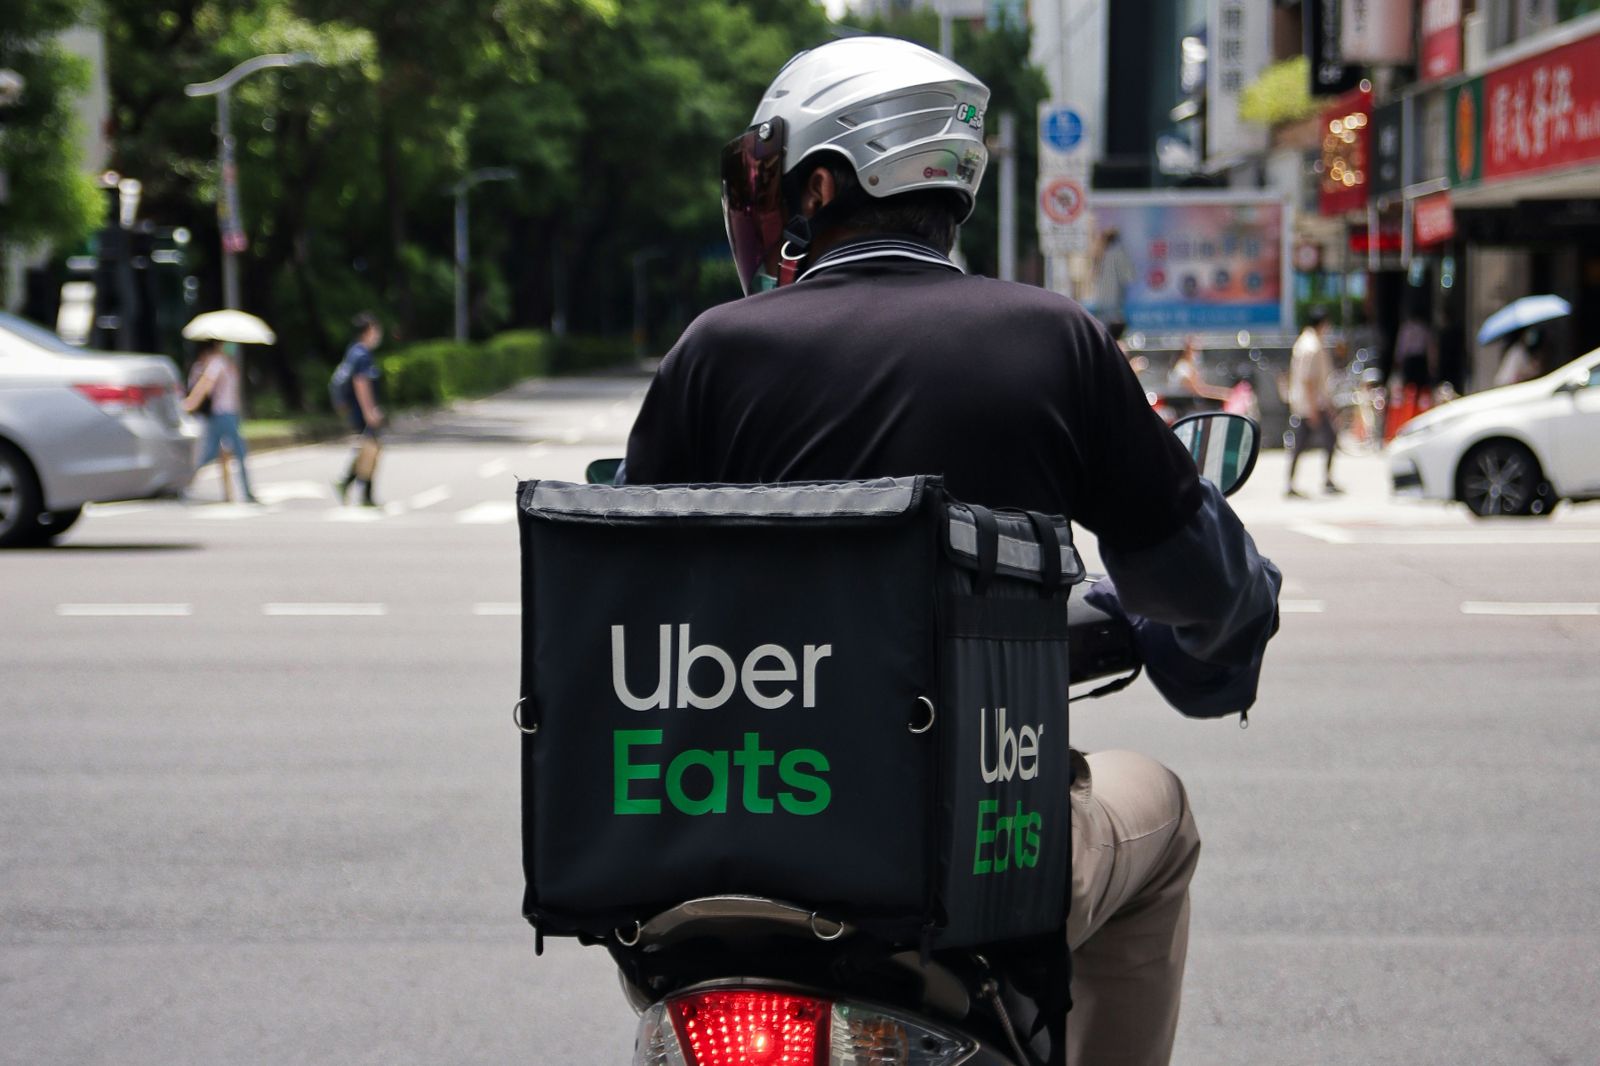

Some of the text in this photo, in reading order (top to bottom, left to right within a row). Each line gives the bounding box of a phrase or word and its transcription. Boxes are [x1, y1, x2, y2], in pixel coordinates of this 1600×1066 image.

[611, 623, 832, 711] Uber
[613, 728, 832, 816] Eats
[980, 707, 1044, 784] Uber
[973, 800, 1042, 876] Eats
